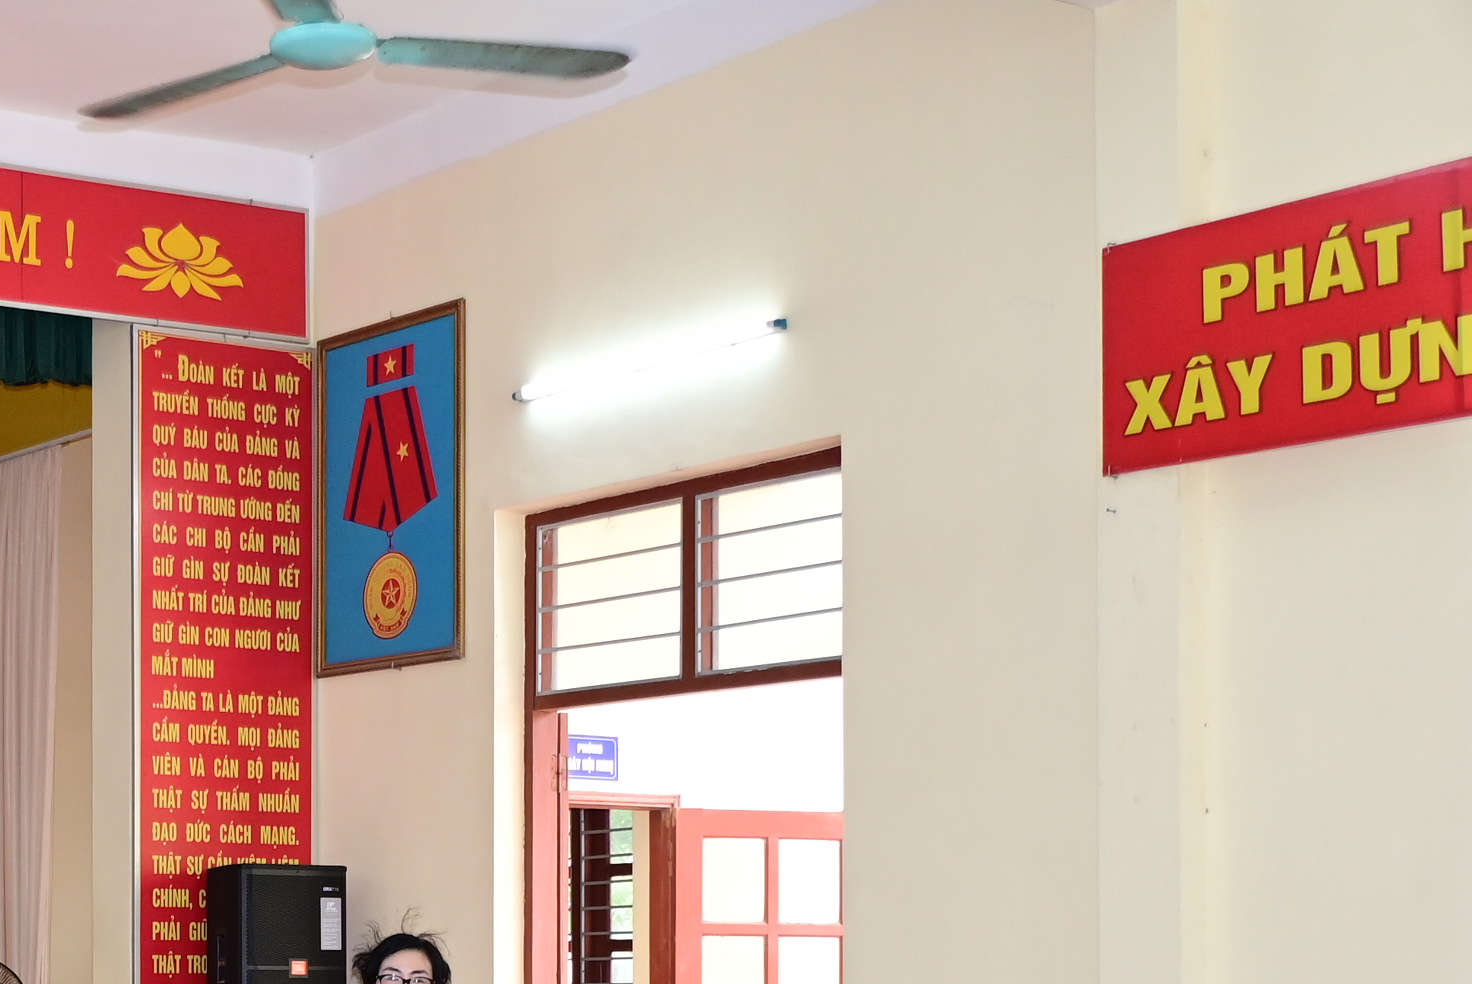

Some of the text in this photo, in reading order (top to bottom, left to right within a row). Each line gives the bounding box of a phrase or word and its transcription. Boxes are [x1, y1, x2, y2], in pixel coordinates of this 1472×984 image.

[1202, 222, 1411, 325] PHÁT
[222, 364, 245, 389] KẾT
[252, 368, 267, 392] LÀ
[275, 371, 300, 399] MỘT
[1126, 314, 1472, 434] XÂY DỰN
[152, 390, 300, 428] TRUYỀN THỐNG CỰC KỲ
[152, 422, 300, 460] QUÝ BÁU CỦA ĐẢNG VÀ
[152, 451, 300, 492] CỦA DÂN TA. CÁC ĐỒNG
[152, 487, 173, 512] CHÍ
[176, 489, 194, 514] TỪ
[196, 494, 236, 518] TRUNG
[276, 498, 300, 524] ĐẾN
[152, 520, 300, 556] CÁC CHI BỘ CẦN PHẢI
[152, 553, 301, 588] GIỮ GÌN SỰ ĐOÀN KẾT
[152, 584, 302, 621] NHẤT TRÍ CỦA ĐẢNG NHƯ
[152, 619, 175, 644] GIỮ
[178, 620, 200, 646] GÌN
[204, 626, 230, 648] CON
[276, 626, 300, 653] CỦA
[151, 649, 215, 679] MẮT MÌNH
[200, 691, 215, 712] TA
[218, 689, 234, 713] LÀ
[238, 691, 264, 719] MỘT
[267, 690, 300, 717] ĐẢNG
[237, 726, 261, 751] MỌI
[267, 722, 300, 749] ĐẢNG
[151, 751, 300, 784] VIÊN VÀ CÁN BỘ PHẢI
[151, 784, 300, 815] THẬT SỰ THẤM NHUẦN
[151, 818, 300, 849] ĐẠO ĐỨC CÁCH MẠNG.
[151, 850, 182, 879] THẬT
[186, 853, 205, 880] SỰ
[152, 915, 181, 941] PHẢI
[151, 950, 182, 979] THẬT
